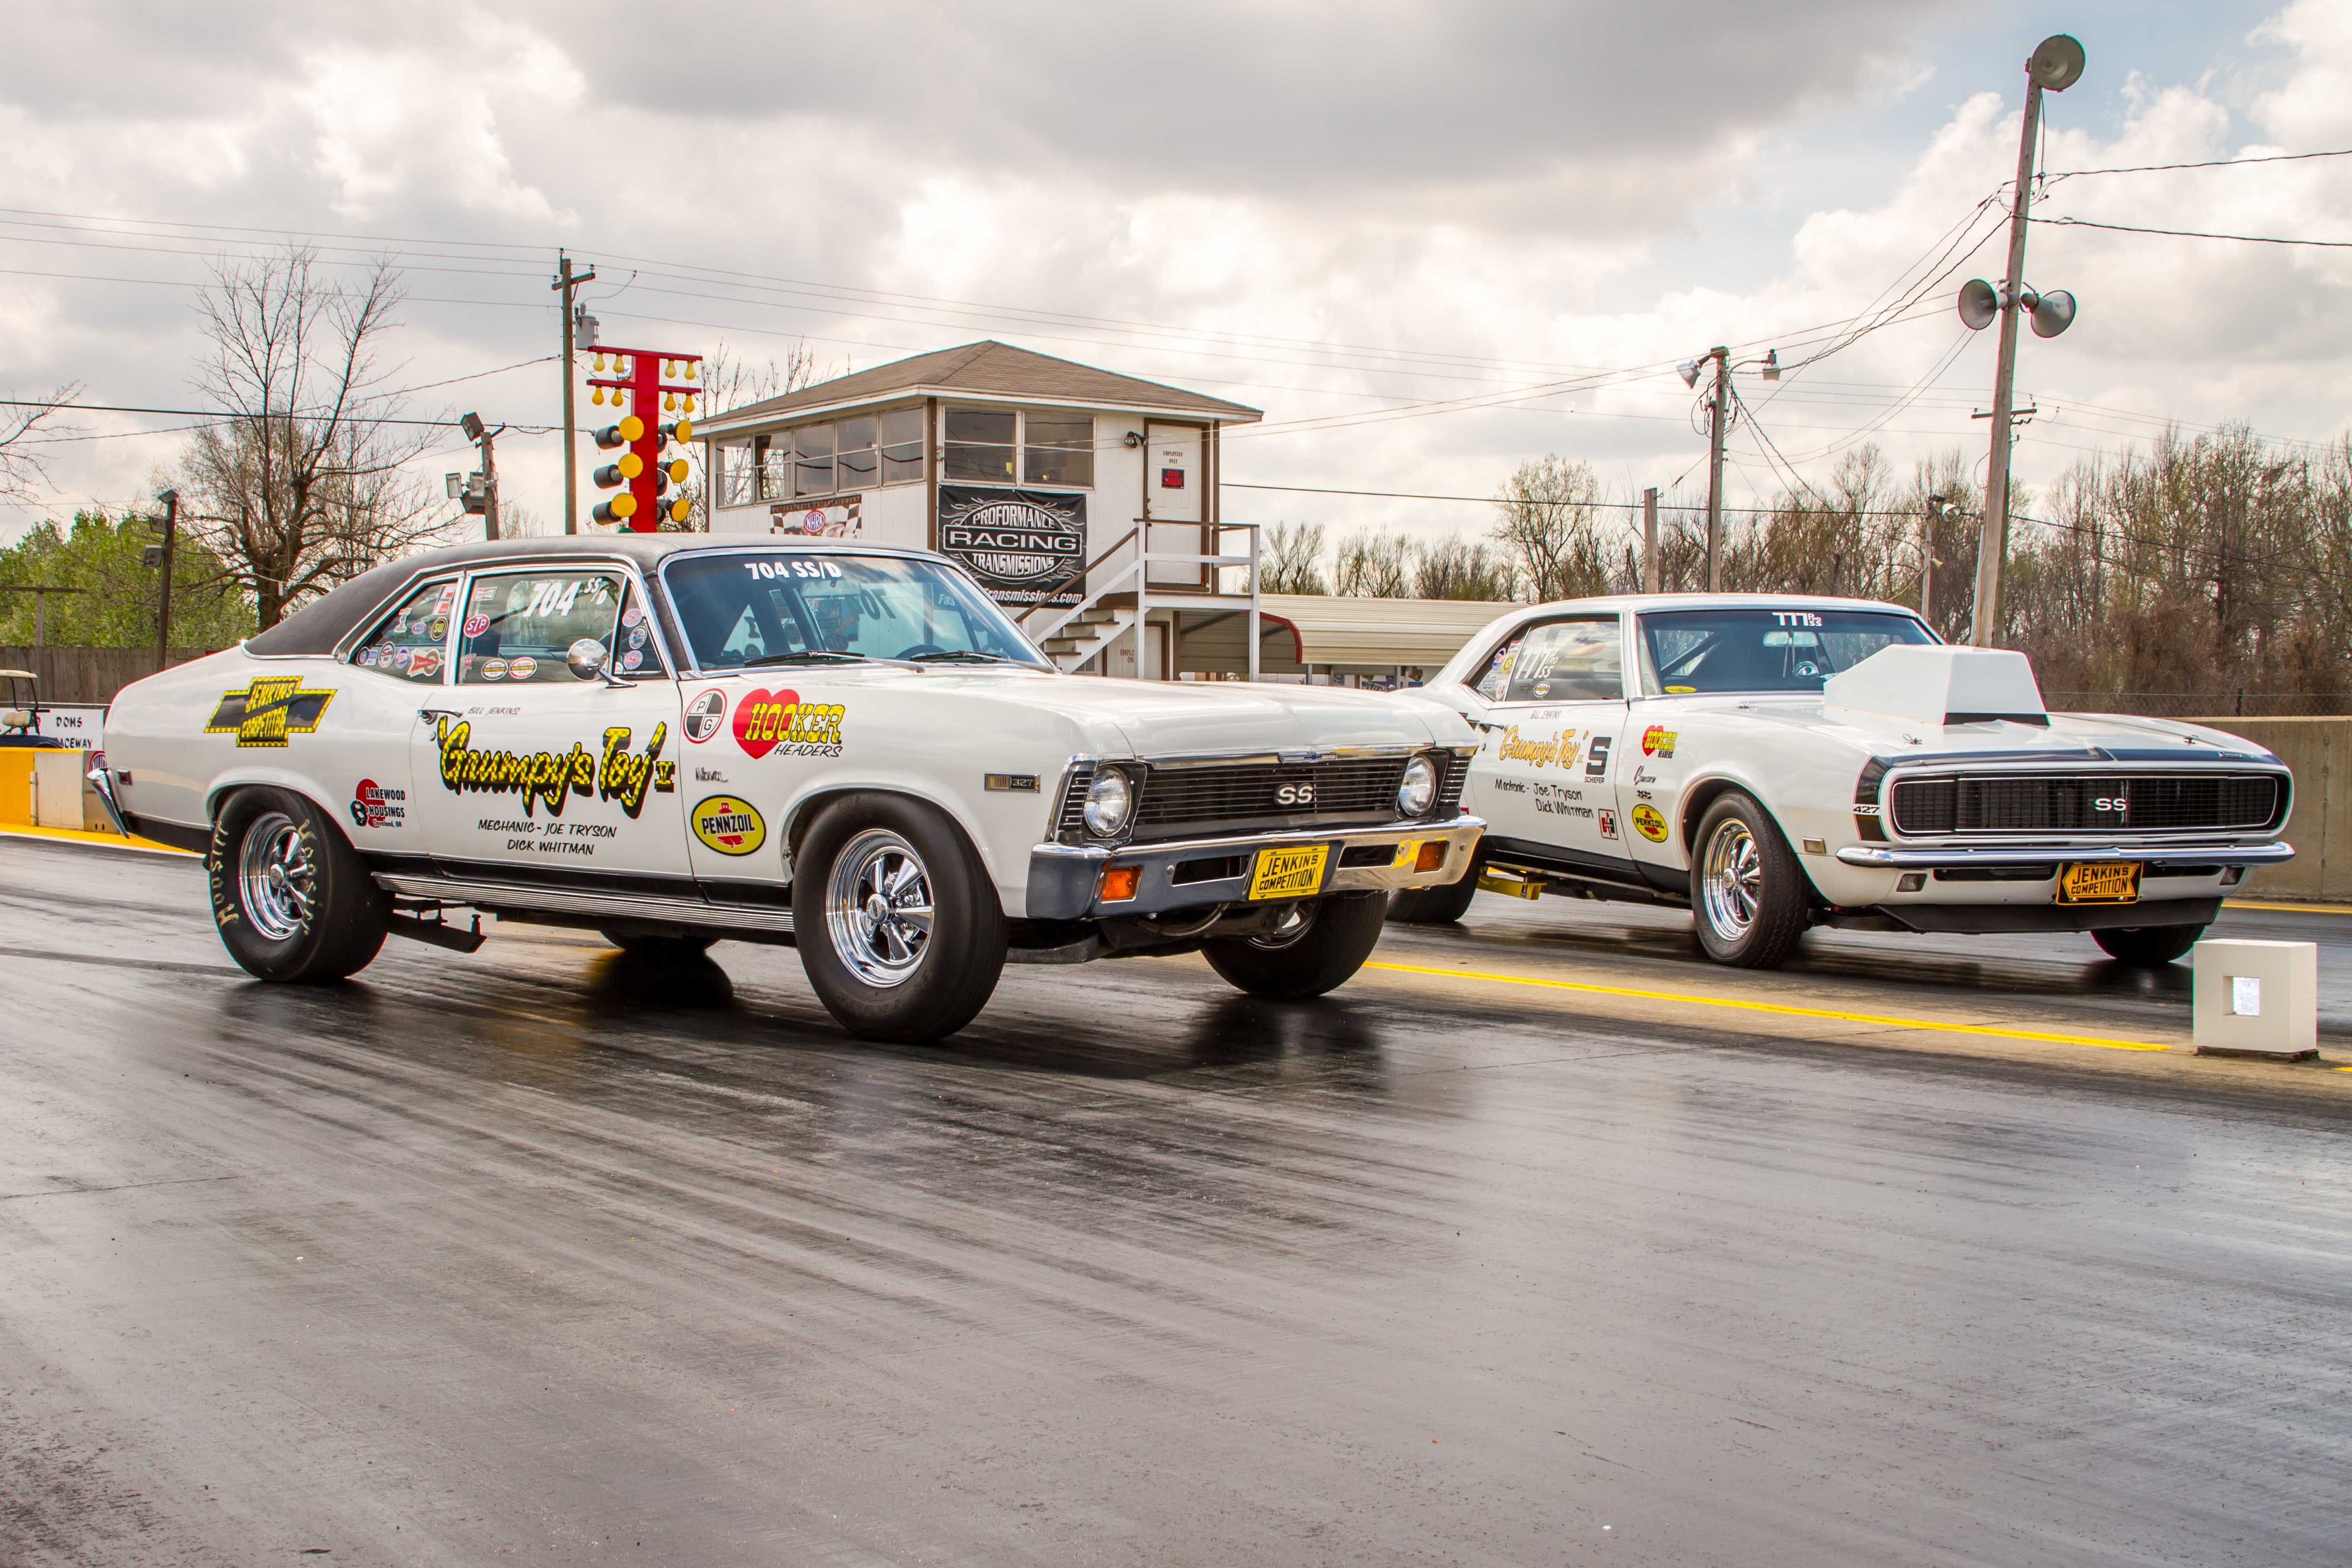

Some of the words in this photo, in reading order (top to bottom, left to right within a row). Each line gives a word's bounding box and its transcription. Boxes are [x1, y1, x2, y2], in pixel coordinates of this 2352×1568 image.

[807, 513, 823, 530] NHRA
[973, 505, 1055, 529] PROFORMANCE
[950, 531, 1076, 551] RACING
[744, 562, 790, 580] 704
[791, 561, 842, 580] SS/D
[972, 553, 1054, 577] TRANSMISSIONS
[522, 581, 582, 617] 704
[984, 588, 1083, 604] ransmissios.com
[467, 616, 487, 632] STP
[1771, 612, 1809, 626] 777
[245, 683, 295, 713] JENKINS
[697, 701, 706, 712] P
[485, 707, 521, 716] JENKINS
[704, 719, 713, 730] G
[744, 702, 845, 745] HOOKER
[774, 744, 843, 757] HEADERS
[1657, 750, 1673, 759] HEADERS
[696, 767, 729, 783] Nova
[366, 788, 405, 801] LAKEWOOD
[1276, 784, 1313, 805] SS
[1533, 783, 1550, 796] Joe
[1550, 784, 1582, 801] Tryson
[369, 805, 405, 818] HOUSINGS
[1535, 798, 1554, 813] Dick
[1554, 801, 1594, 819] Whitman
[2094, 798, 2126, 811] SS
[544, 823, 565, 836] JOE
[569, 824, 617, 838] TRYSON
[701, 814, 755, 835] PENNZOIL
[1635, 817, 1665, 829] PENNZOIL
[507, 839, 535, 852] DICK
[539, 842, 595, 855] WHITMAN
[1262, 854, 1319, 878] JENKINS
[1258, 867, 1316, 890] COMPETITION
[2072, 867, 2129, 885] JENKINS
[2071, 876, 2128, 894] COMPETITION
